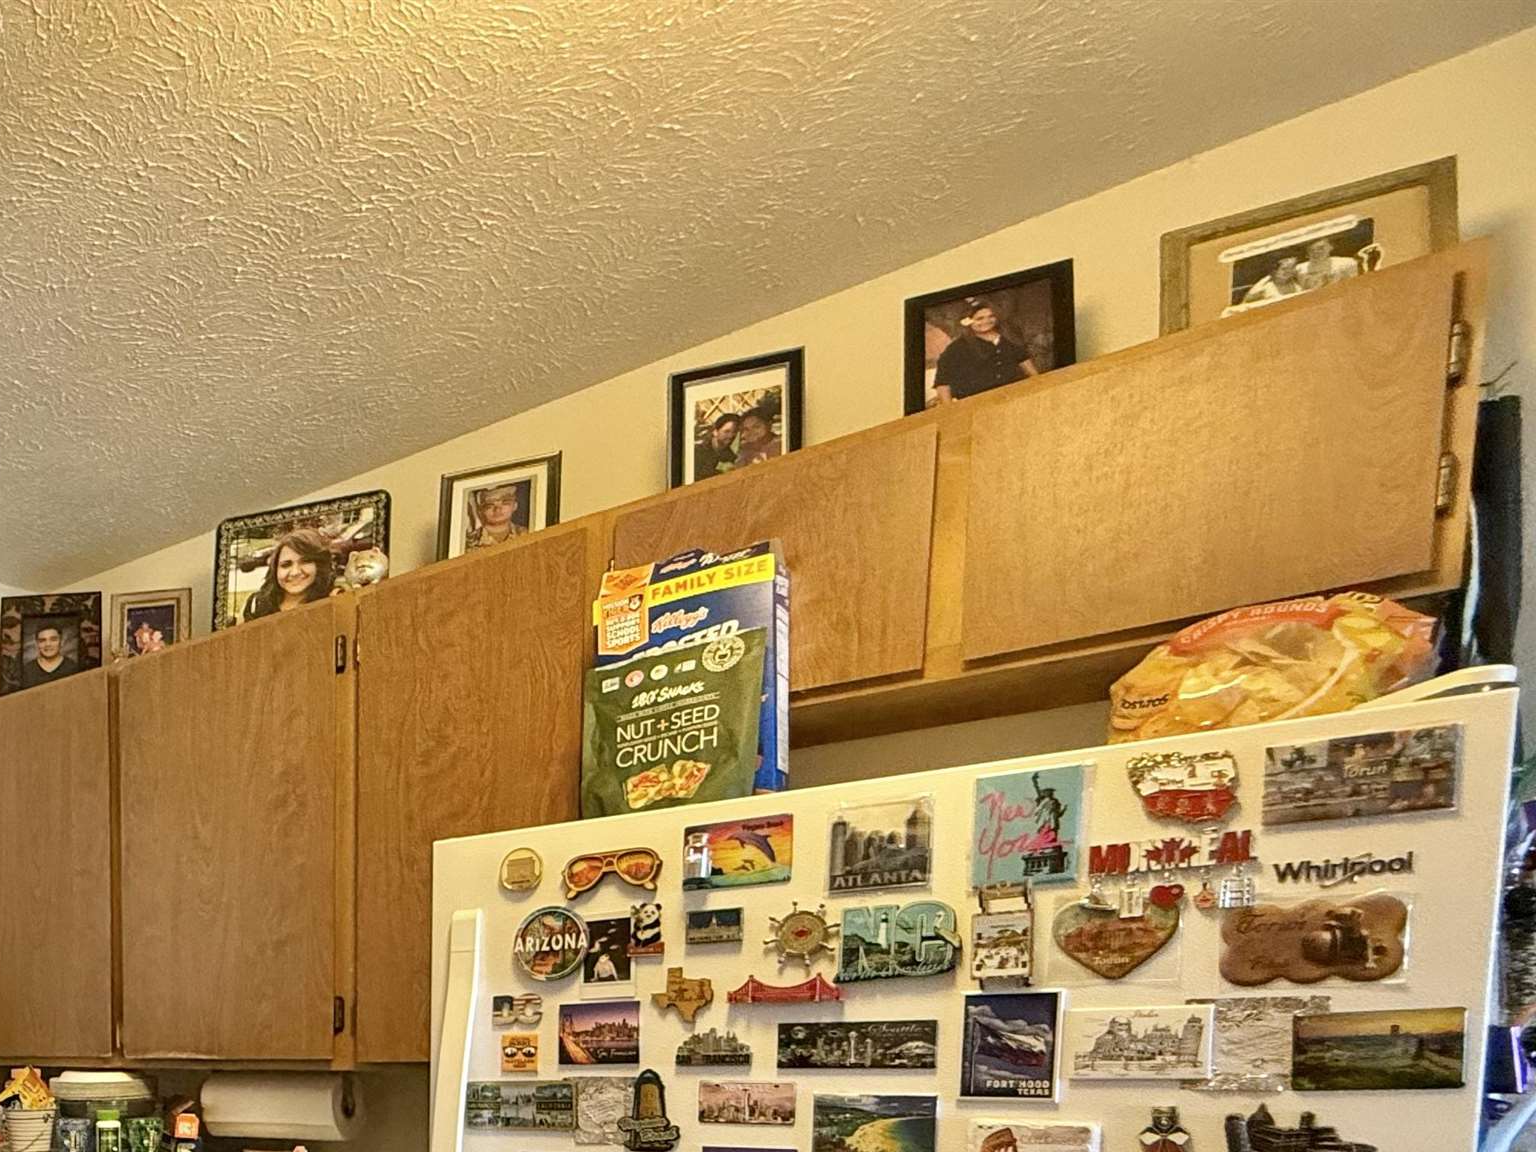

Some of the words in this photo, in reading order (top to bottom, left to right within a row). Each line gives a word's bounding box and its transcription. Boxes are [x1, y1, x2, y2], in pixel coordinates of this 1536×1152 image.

[651, 572, 717, 600] FAMILY
[725, 558, 769, 581] SIZE
[1180, 607, 1242, 645] CRISPY
[1248, 602, 1329, 617] ROUNDS
[616, 718, 655, 743] NUT
[670, 704, 721, 729] SEED
[615, 726, 719, 768] CRUNCH
[979, 824, 1072, 880] York
[1273, 851, 1414, 887] Whirlpool
[833, 870, 925, 888] ATLANTA
[514, 932, 588, 953] ARIZONA
[703, 1053, 750, 1066] FRANCISCO
[985, 1080, 1015, 1089] FORT
[1017, 1079, 1051, 1089] HOOD
[1017, 1088, 1051, 1096] TEXAS
